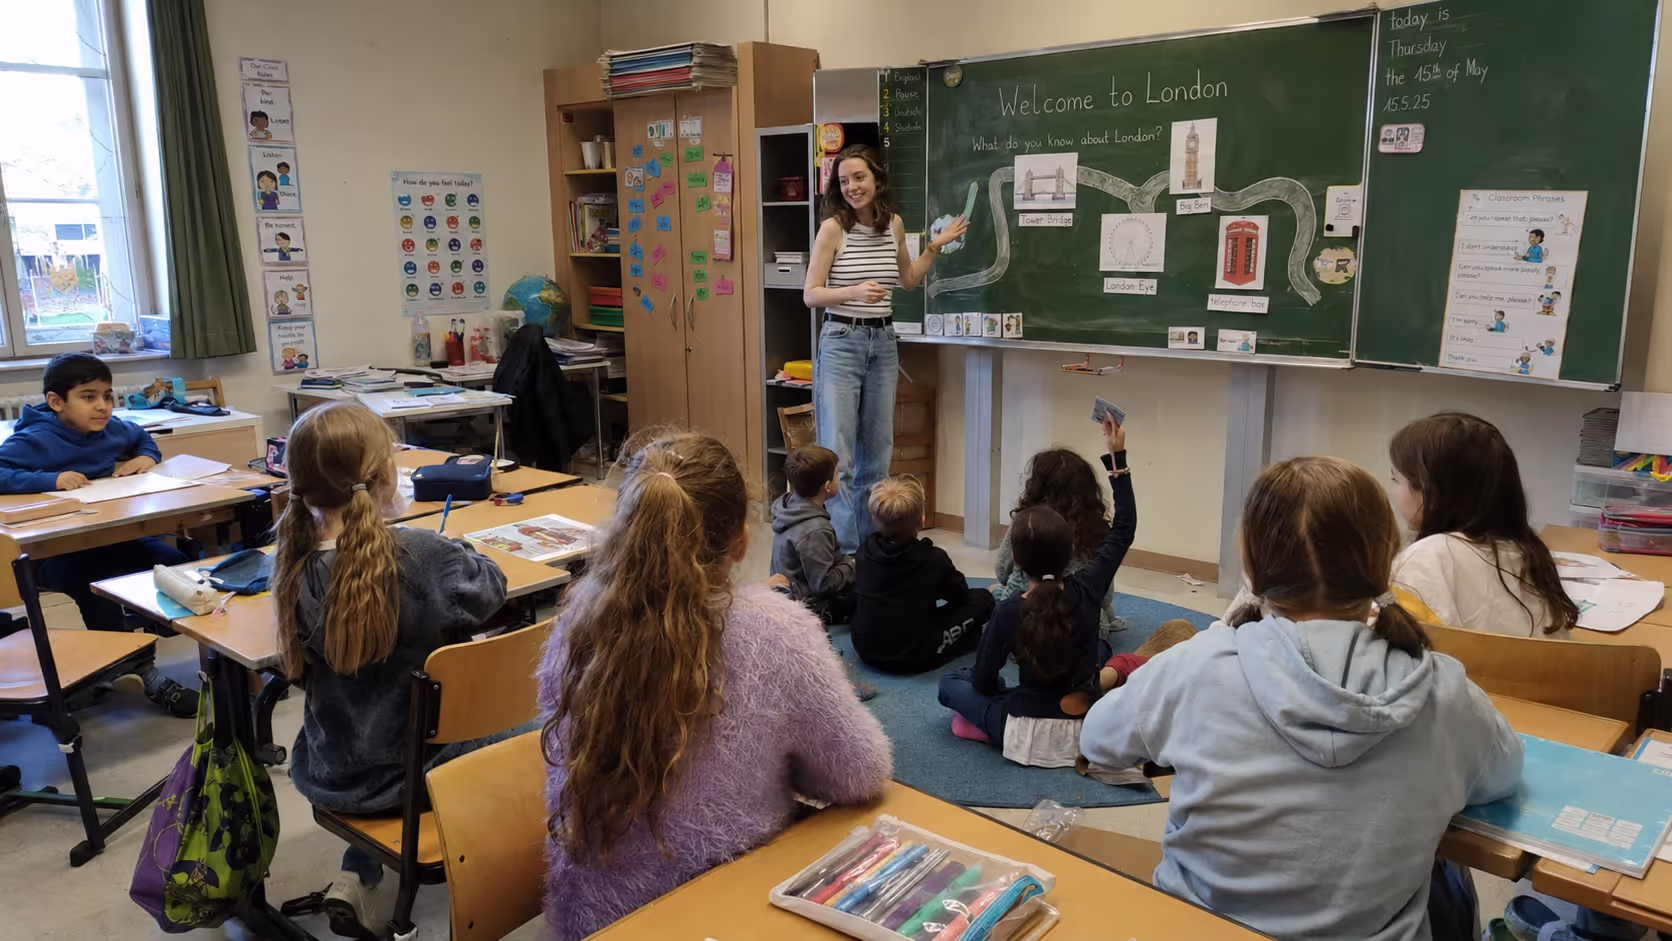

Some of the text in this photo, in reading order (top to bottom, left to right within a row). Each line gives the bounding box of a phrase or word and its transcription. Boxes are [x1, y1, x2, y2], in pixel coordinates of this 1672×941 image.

[1389, 7, 1450, 31] today is
[1387, 35, 1447, 58] Thursday
[1385, 58, 1489, 87] the 15th of May
[883, 88, 891, 99] 2
[998, 68, 1229, 117] Welcome to London
[1383, 93, 1431, 112] 15.5.25
[883, 107, 890, 117] 3
[883, 121, 890, 133] 4
[883, 136, 891, 148] 5
[972, 125, 1163, 155] What do you know about London?
[403, 178, 418, 186] How
[420, 178, 427, 186] do
[428, 180, 440, 188] you
[441, 179, 453, 187] feel
[1488, 193, 1565, 203] Classroom Phrases
[1179, 200, 1209, 213] Big Ben
[1020, 214, 1072, 227] Tower Bridge
[1105, 277, 1155, 295] London Eye
